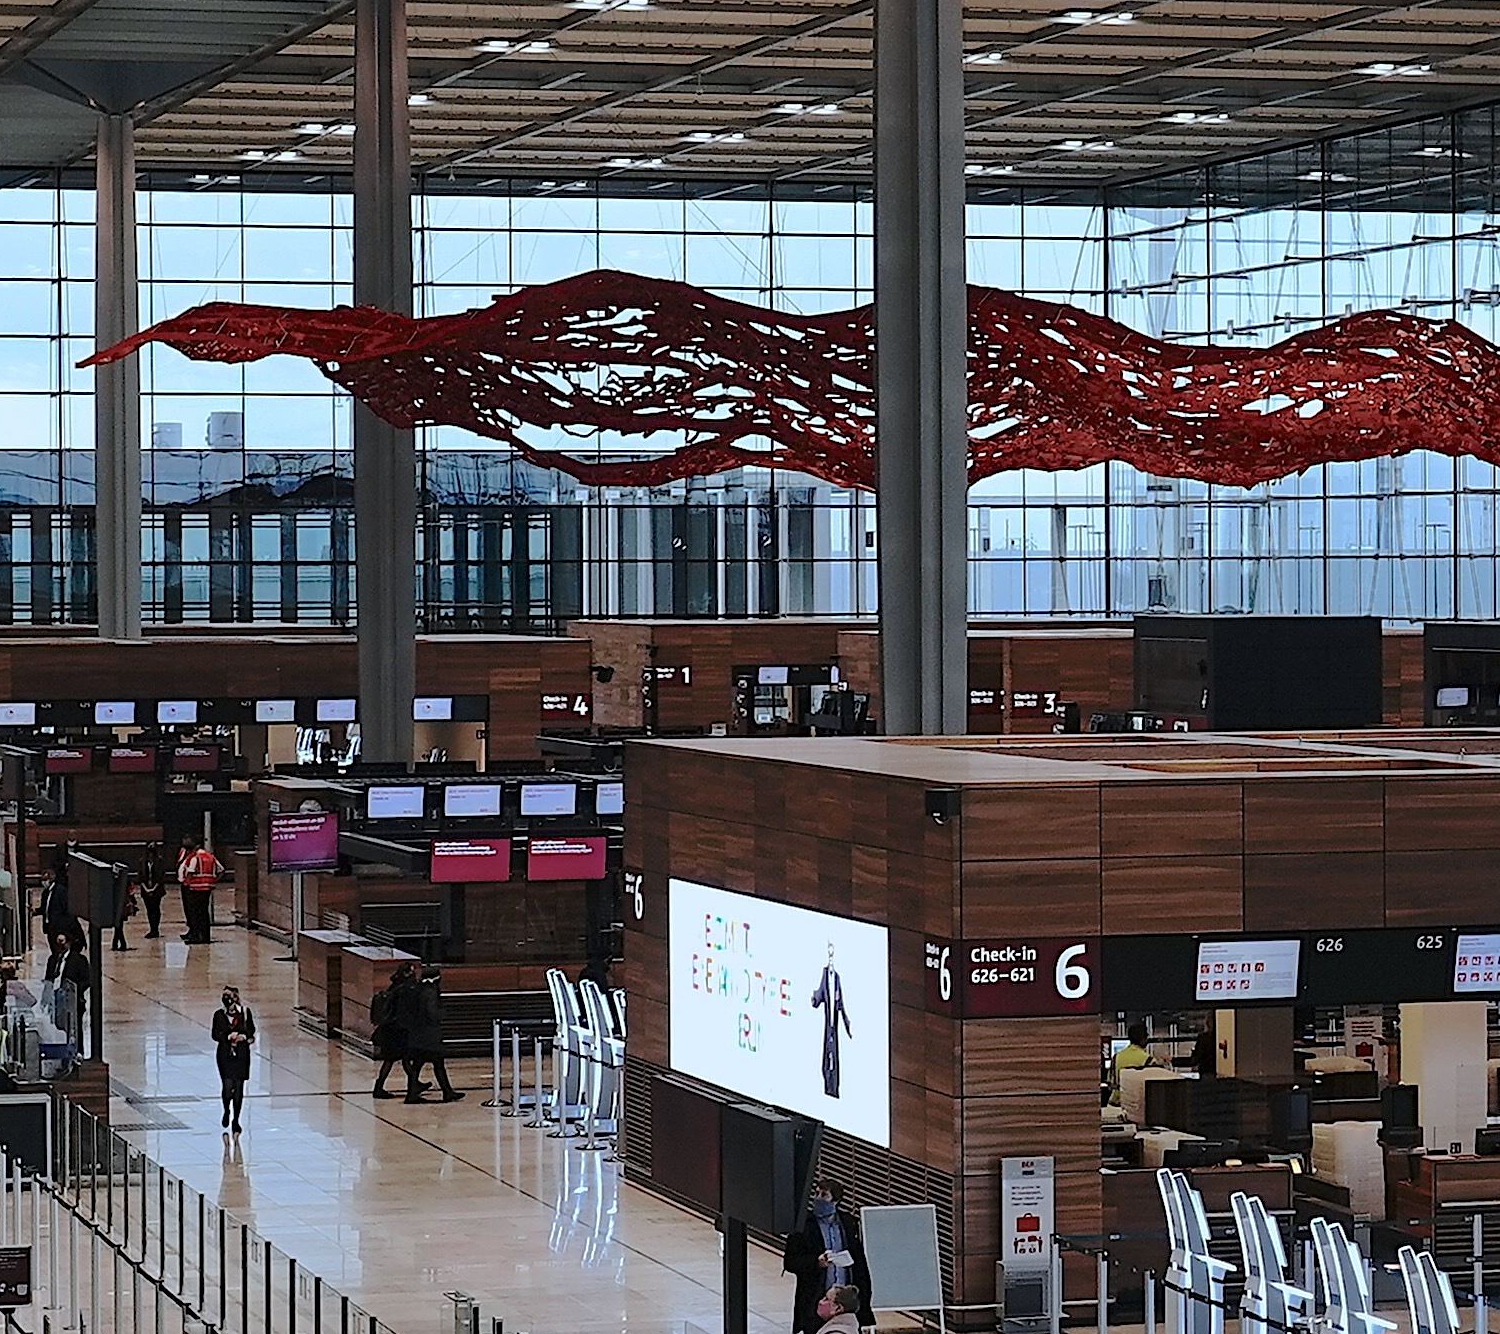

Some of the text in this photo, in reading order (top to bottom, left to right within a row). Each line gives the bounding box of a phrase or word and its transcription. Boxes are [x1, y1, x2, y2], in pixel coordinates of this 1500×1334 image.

[681, 667, 690, 684] 1
[572, 695, 589, 716] 4
[1043, 693, 1056, 714] 3
[1316, 938, 1344, 953] 626
[1416, 935, 1443, 950] 625
[971, 945, 1037, 963] Check-in
[940, 946, 951, 1001] 6
[1055, 943, 1090, 999] 6
